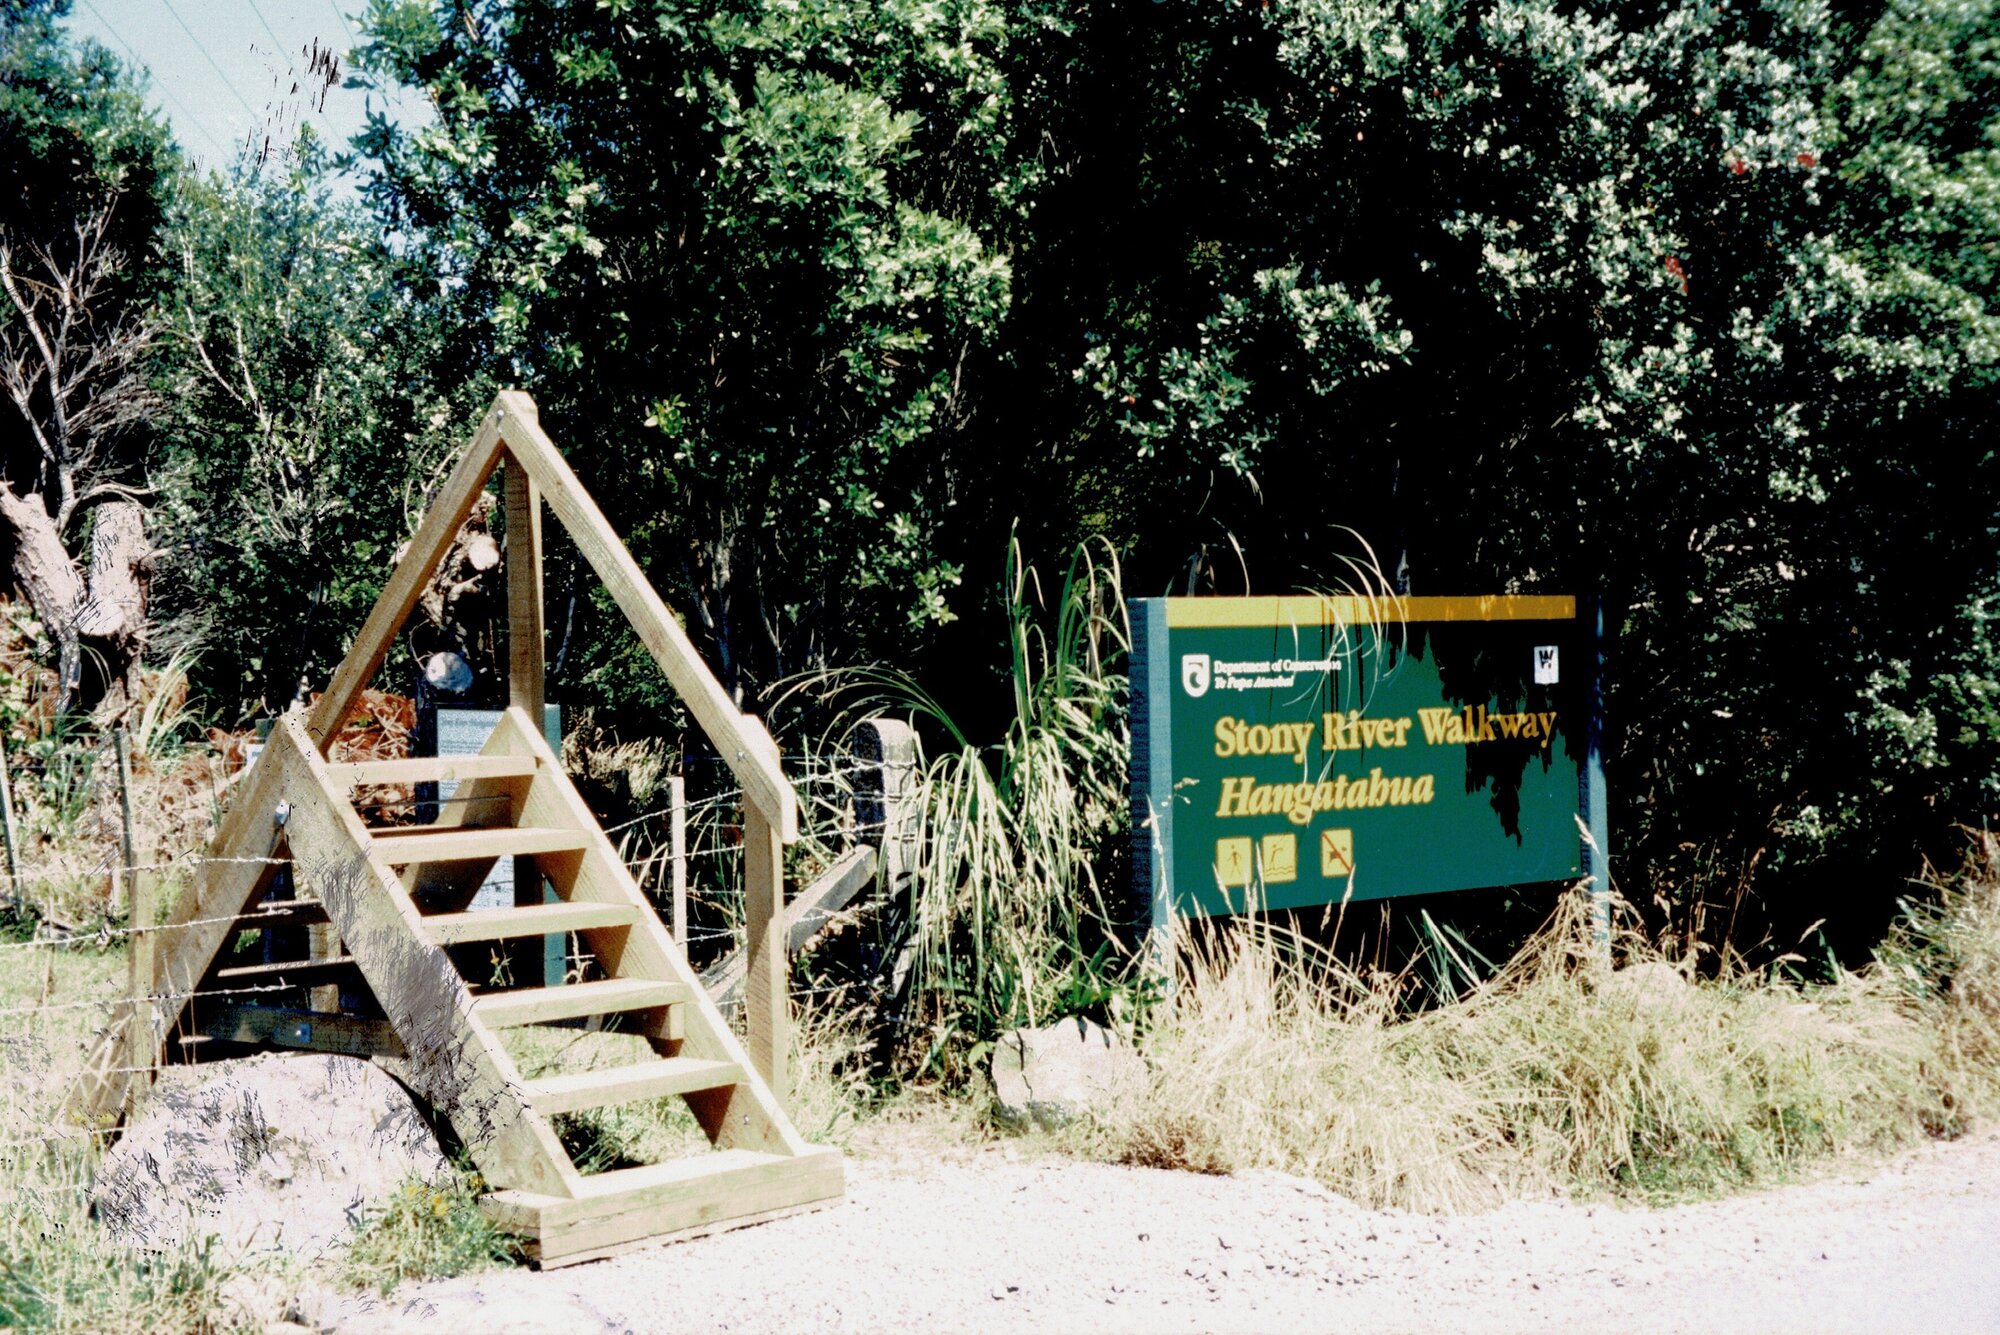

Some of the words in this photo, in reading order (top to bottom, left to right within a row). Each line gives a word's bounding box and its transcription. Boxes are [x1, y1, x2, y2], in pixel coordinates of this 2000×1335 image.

[1214, 661, 1270, 676] Department
[1271, 659, 1282, 672] of
[1215, 716, 1315, 764] Stony
[1322, 709, 1412, 751] River
[1417, 704, 1557, 749] Walkway
[1215, 766, 1435, 826] Hangatahua
